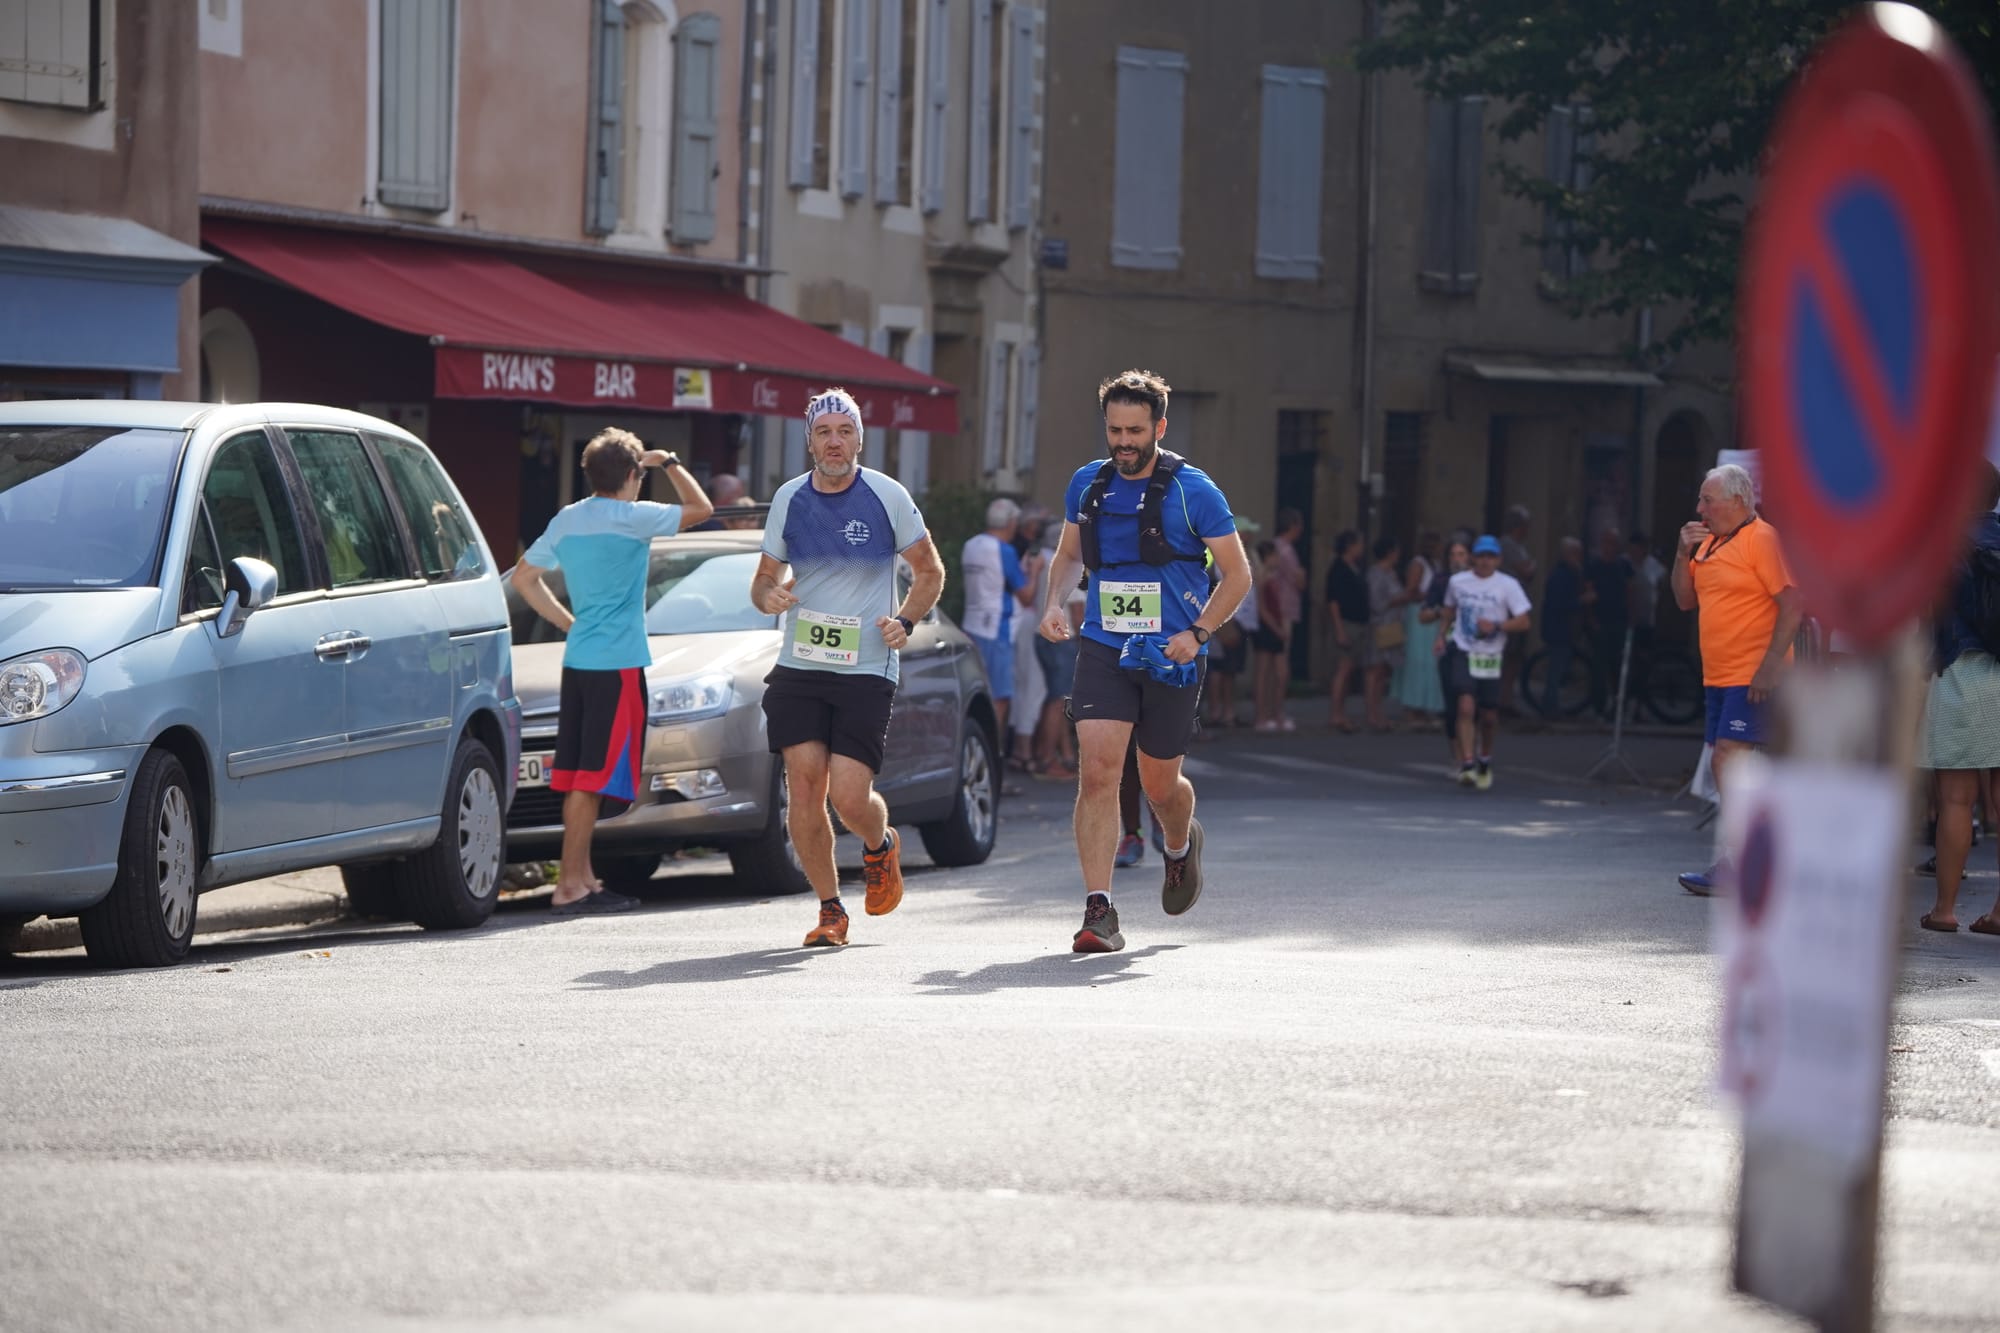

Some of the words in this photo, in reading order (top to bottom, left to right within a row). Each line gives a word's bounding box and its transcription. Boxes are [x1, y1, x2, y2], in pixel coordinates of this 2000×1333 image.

[483, 353, 555, 392] RYAN'S
[594, 362, 636, 398] BAR
[1112, 596, 1142, 616] 34
[810, 625, 842, 647] 95
